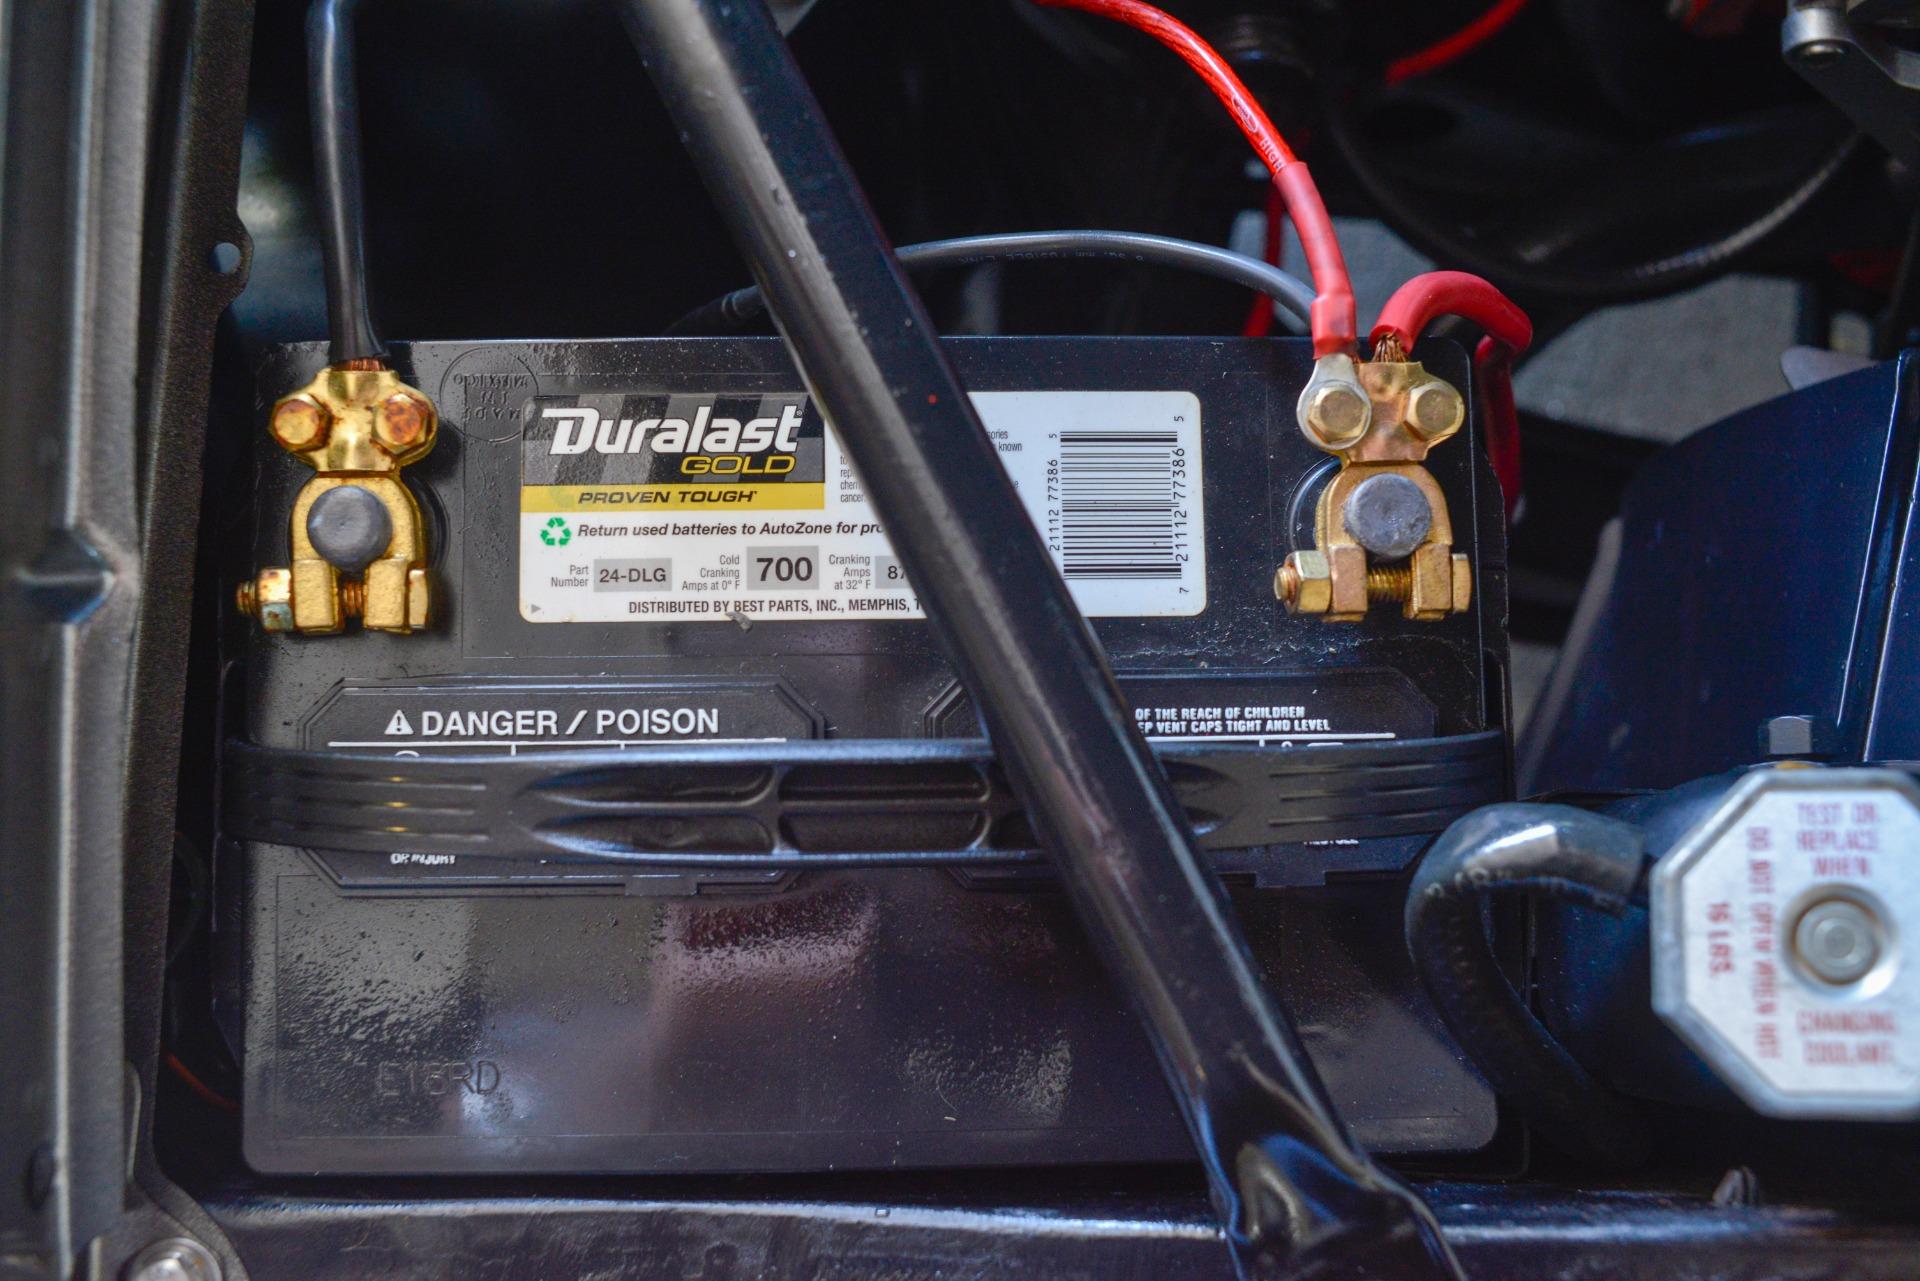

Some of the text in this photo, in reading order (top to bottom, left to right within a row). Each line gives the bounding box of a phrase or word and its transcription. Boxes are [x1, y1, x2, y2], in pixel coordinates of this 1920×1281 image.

[542, 404, 802, 454] Duralast
[998, 441, 1022, 452] known
[680, 455, 796, 474] GOLD
[1047, 459, 1059, 502] 77386
[1172, 448, 1186, 501] 77386
[578, 491, 754, 504] PROVEN TOUGH
[578, 524, 628, 537] Return
[632, 523, 669, 536] used
[672, 522, 737, 536] batteries
[742, 523, 756, 535] to
[760, 522, 833, 535] AutoZone
[836, 521, 858, 534] for
[1048, 509, 1060, 552] 21112
[1174, 510, 1188, 562] 21112
[719, 555, 740, 565] Cold
[828, 554, 871, 566] Cranking
[569, 564, 589, 576] Part
[599, 568, 667, 583] 24-DLG
[700, 567, 741, 580] Cranking
[756, 556, 813, 582] 700
[843, 567, 871, 578] Amps
[551, 576, 589, 588] Number
[682, 581, 708, 593] Amps
[710, 581, 719, 591] at
[735, 580, 741, 590] F
[834, 580, 843, 590] at
[865, 580, 871, 590] F
[629, 601, 710, 614] DISTRIBUTED
[713, 600, 730, 613] BY
[733, 600, 765, 612] BEST
[768, 599, 813, 614] PARTS,
[816, 599, 845, 613] INC.,
[848, 598, 910, 612] MEMPHIS,
[1135, 706, 1306, 721] OF THE REACH OF CHILDREN
[422, 708, 719, 736] DANGER / POISON
[1156, 721, 1188, 733] VENT
[1191, 721, 1223, 733] CAPS
[1225, 720, 1262, 732] TIGHT
[1265, 720, 1290, 732] AND
[1294, 719, 1331, 732] LEVEL
[1796, 830, 1880, 852] REPLACE
[1748, 860, 1774, 894] NOT
[1750, 902, 1775, 953] OPEN
[1753, 960, 1777, 1015] WHEN
[1755, 1023, 1782, 1058] HOT
